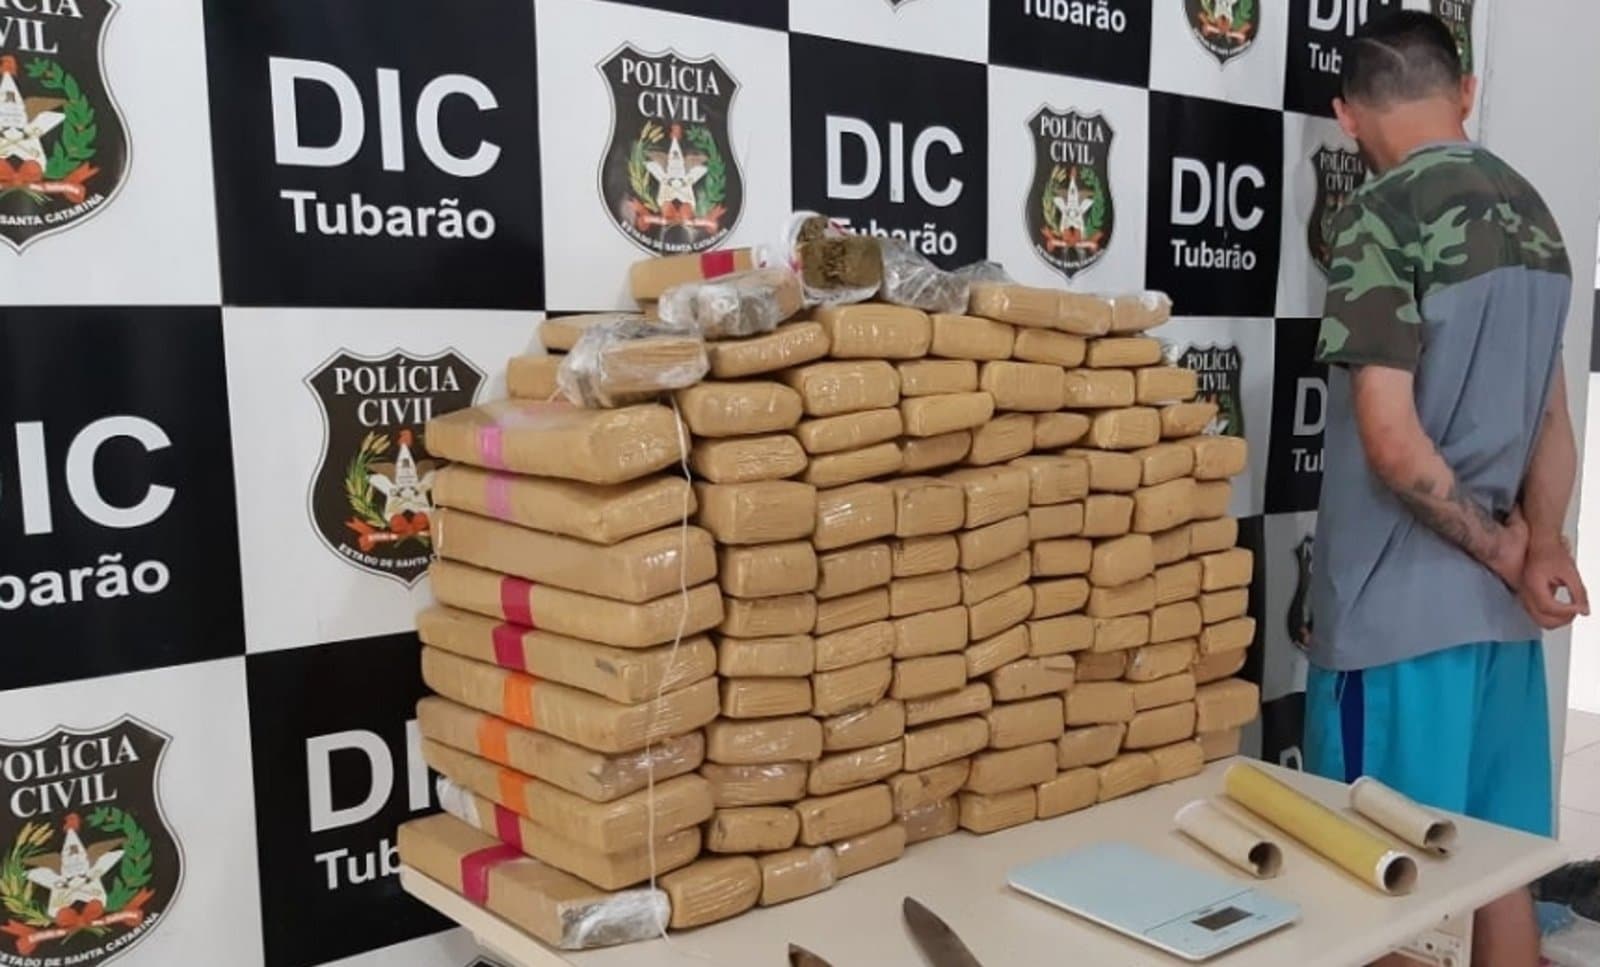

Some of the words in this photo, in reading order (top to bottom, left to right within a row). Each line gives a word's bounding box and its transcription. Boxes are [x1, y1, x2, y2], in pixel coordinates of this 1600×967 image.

[621, 57, 720, 95] POLÍCIA
[269, 56, 501, 177] DIC
[638, 90, 706, 122] CIVIL
[1040, 111, 1104, 143] POLÍCIA
[826, 115, 963, 207] DIC
[1050, 139, 1095, 165] CIVIL
[280, 189, 496, 239] Tubarão
[1171, 156, 1265, 231] DIC
[1170, 239, 1257, 271] Tubarão
[335, 358, 460, 395] POLÍCIA
[14, 415, 176, 535] IC
[0, 735, 140, 782] OLÍCIA
[306, 720, 430, 833] DI
[10, 772, 118, 818] CIVIL
